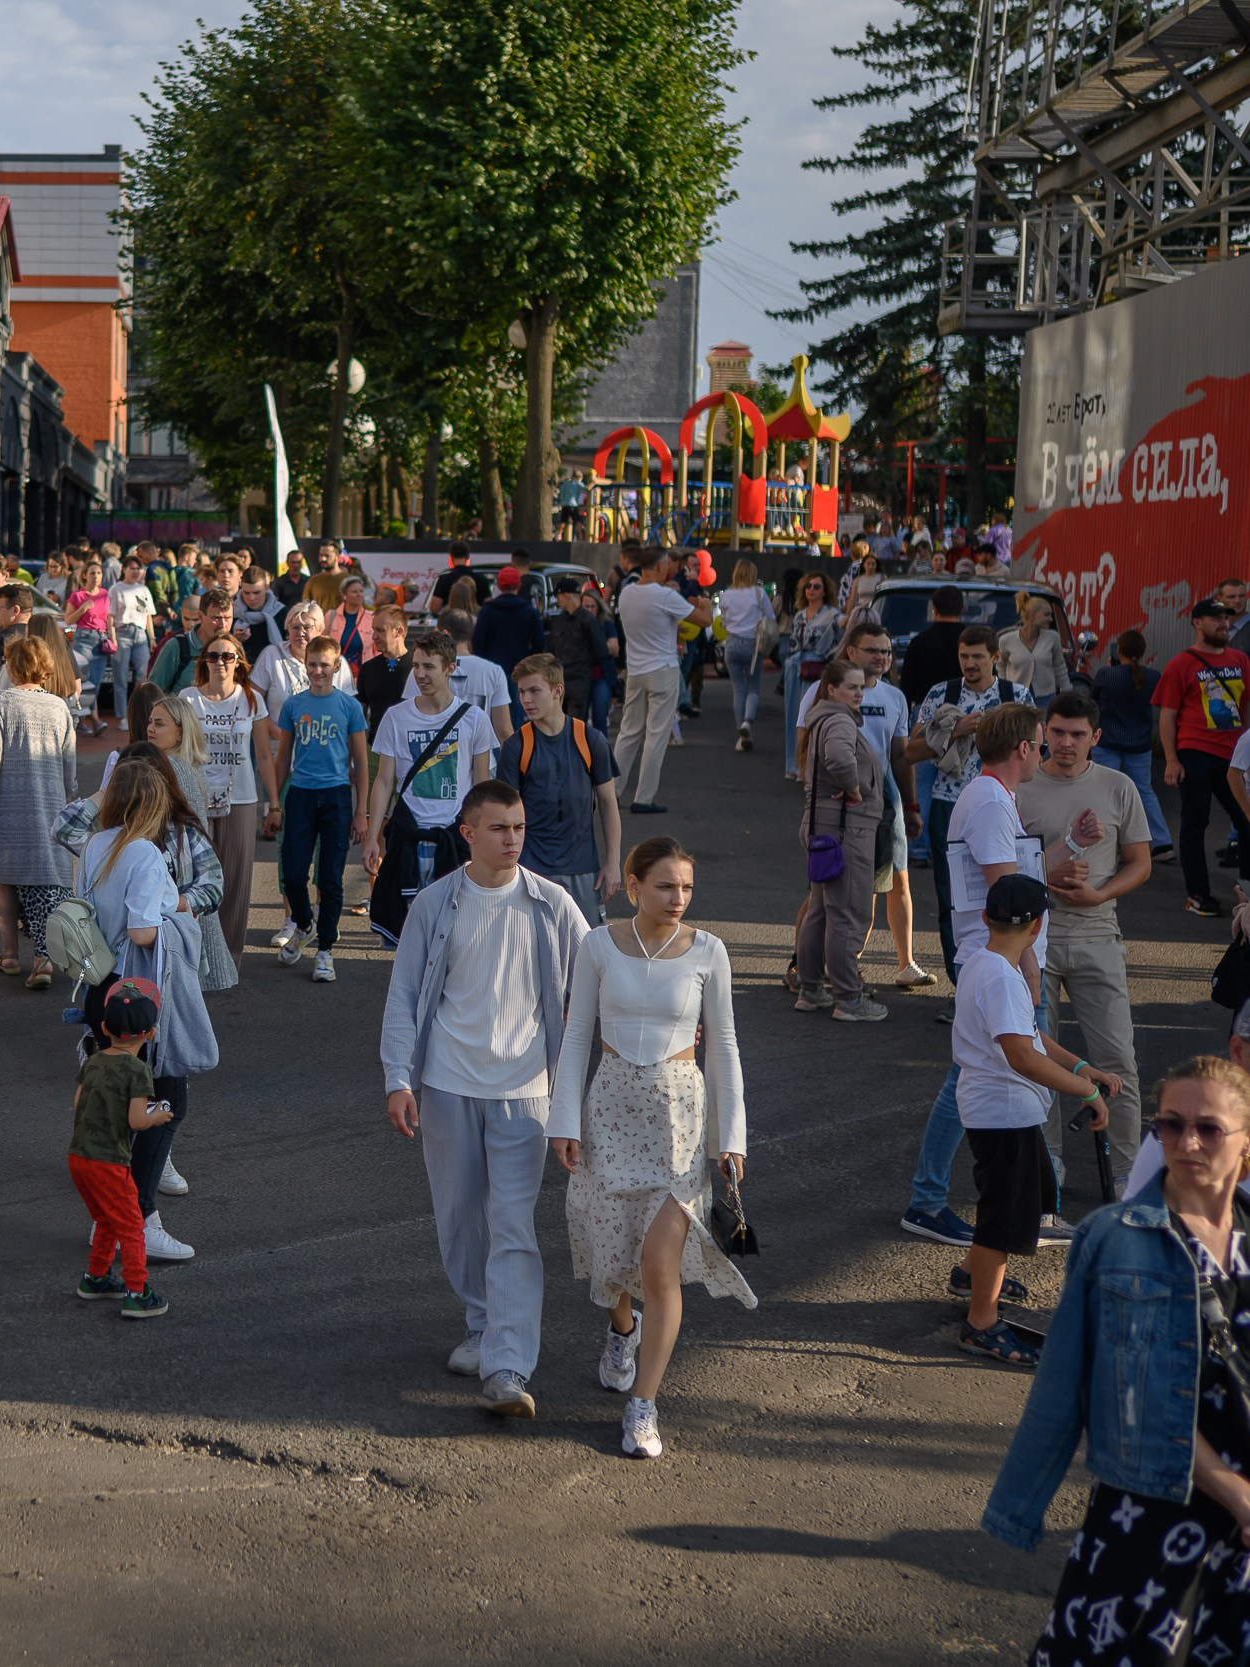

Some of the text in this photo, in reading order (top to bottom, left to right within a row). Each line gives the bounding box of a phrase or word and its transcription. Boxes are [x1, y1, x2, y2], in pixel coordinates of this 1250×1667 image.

[1039, 432, 1230, 516] В чём сила,
[1224, 667, 1235, 678] Do
[205, 714, 233, 726] PAST
[203, 732, 245, 745] RESENT
[408, 730, 458, 742] Pro Tis
[207, 752, 242, 766] UTURE
